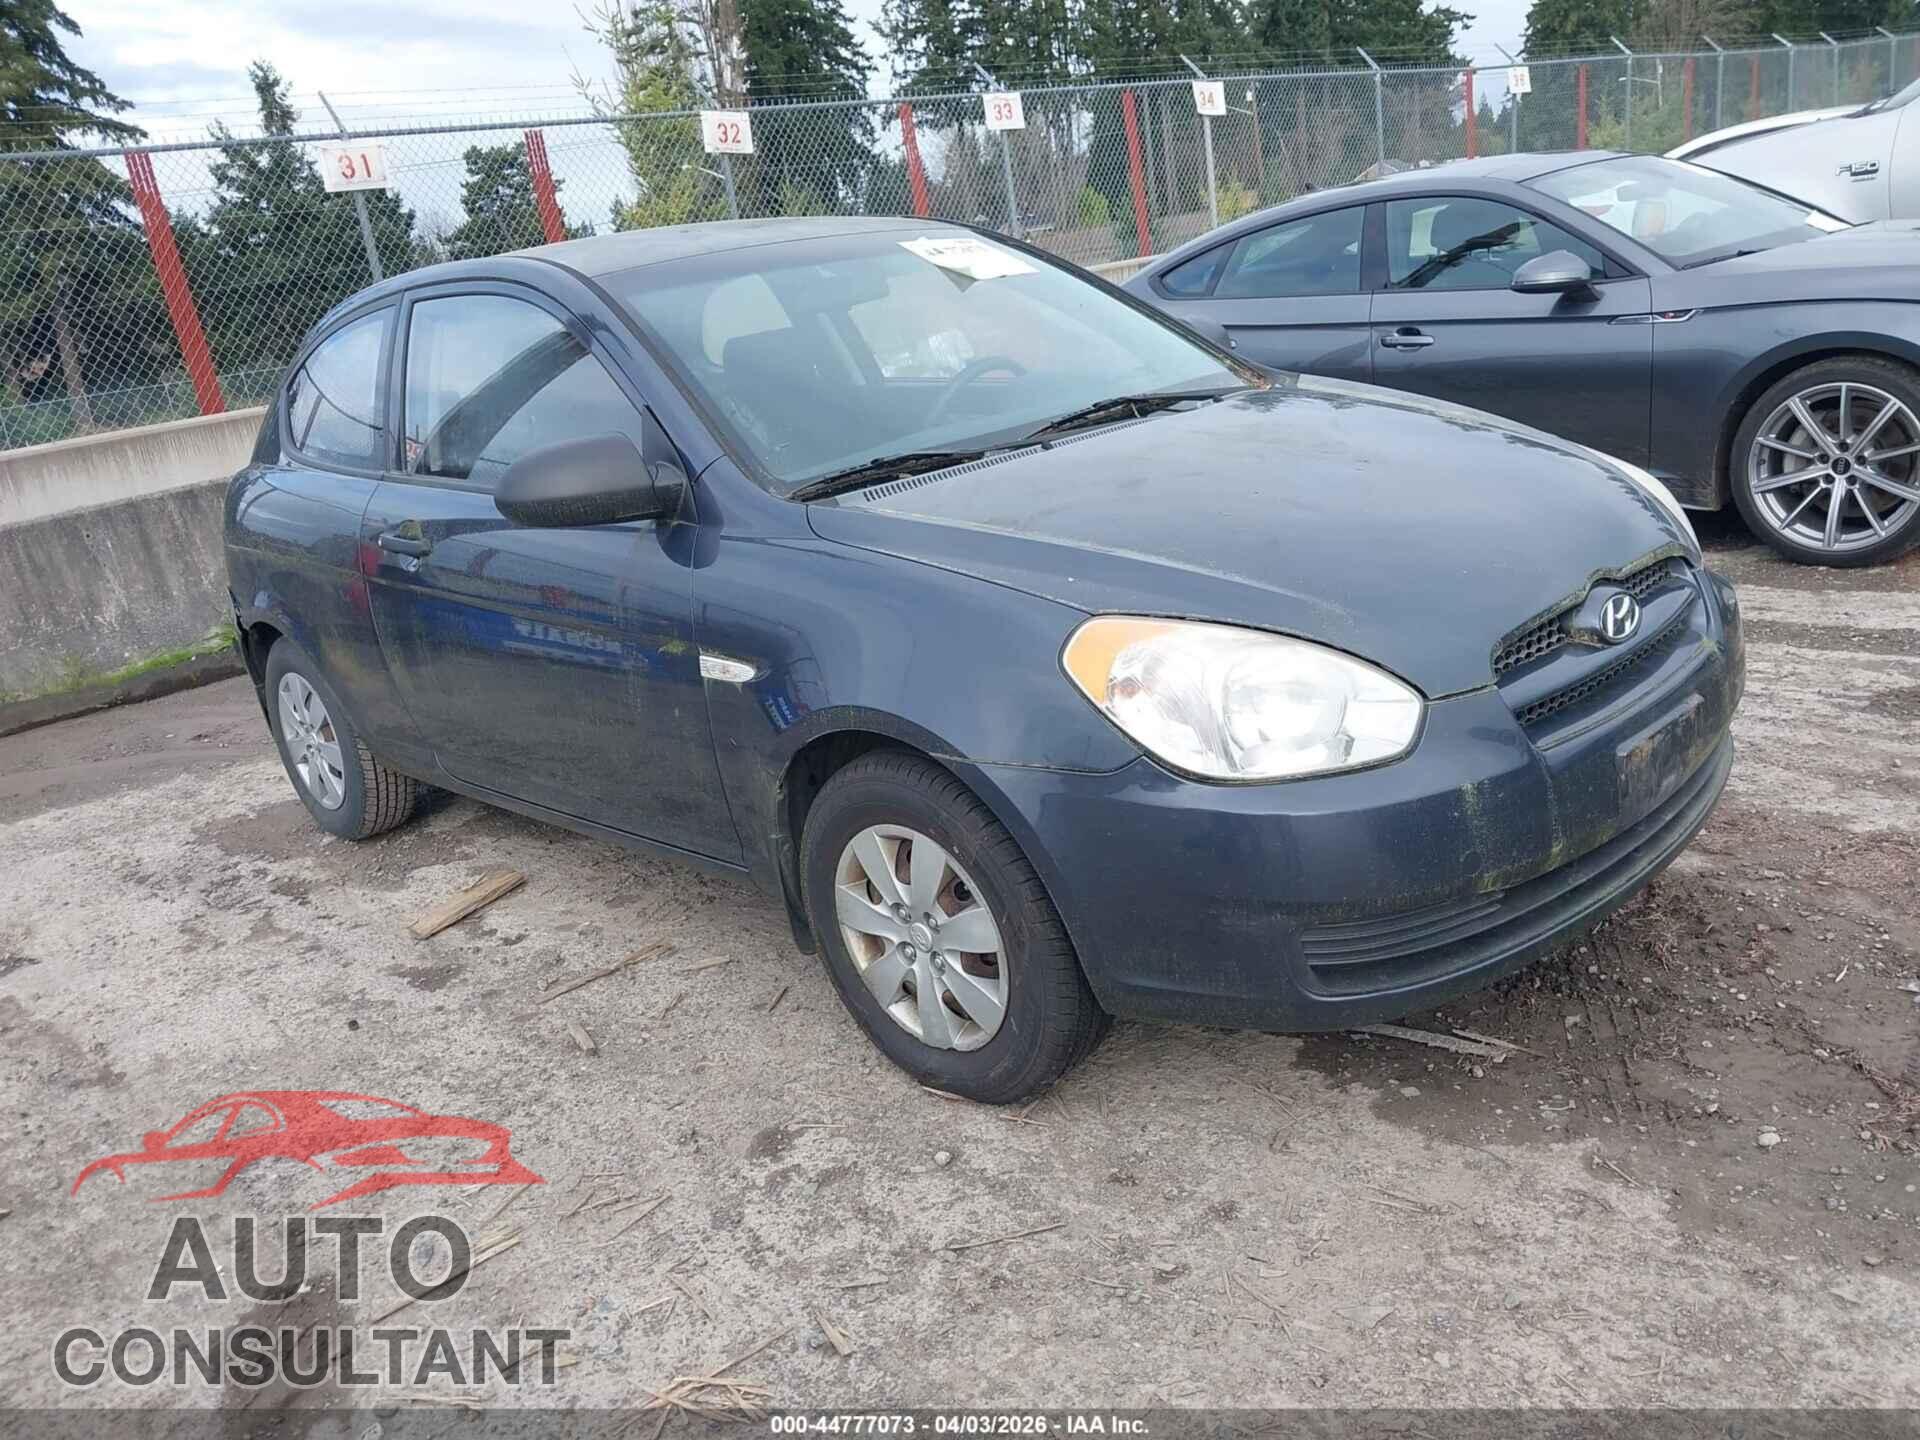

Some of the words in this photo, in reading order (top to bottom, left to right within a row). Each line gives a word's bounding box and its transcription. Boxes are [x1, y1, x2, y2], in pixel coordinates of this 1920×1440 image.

[1200, 91, 1215, 107] 34
[993, 102, 1013, 120] 33
[717, 122, 741, 143] 32
[338, 153, 371, 179] 31
